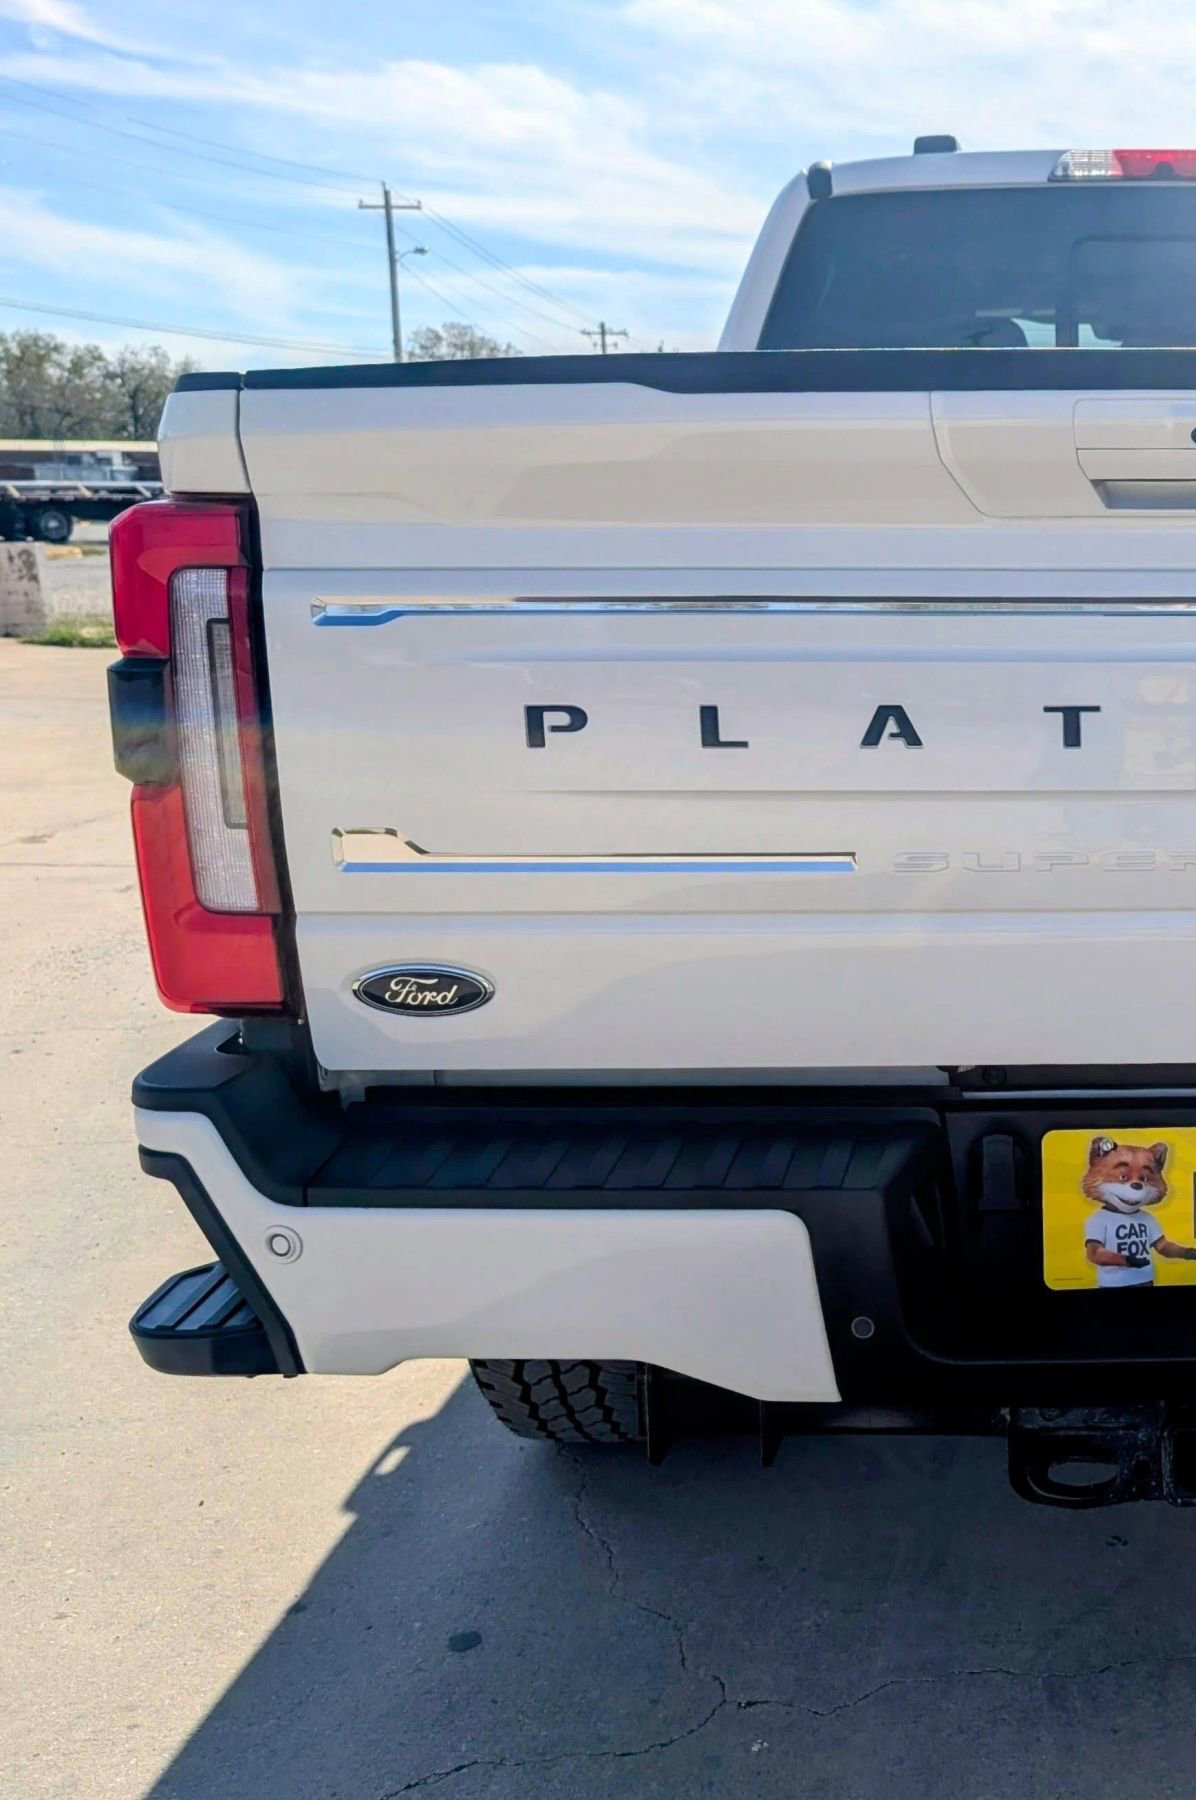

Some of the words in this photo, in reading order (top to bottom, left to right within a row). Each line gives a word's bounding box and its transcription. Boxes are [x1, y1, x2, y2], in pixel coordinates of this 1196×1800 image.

[384, 976, 459, 1006] Ford
[1115, 1222, 1148, 1240] CAR
[1116, 1239, 1150, 1256] FOX
